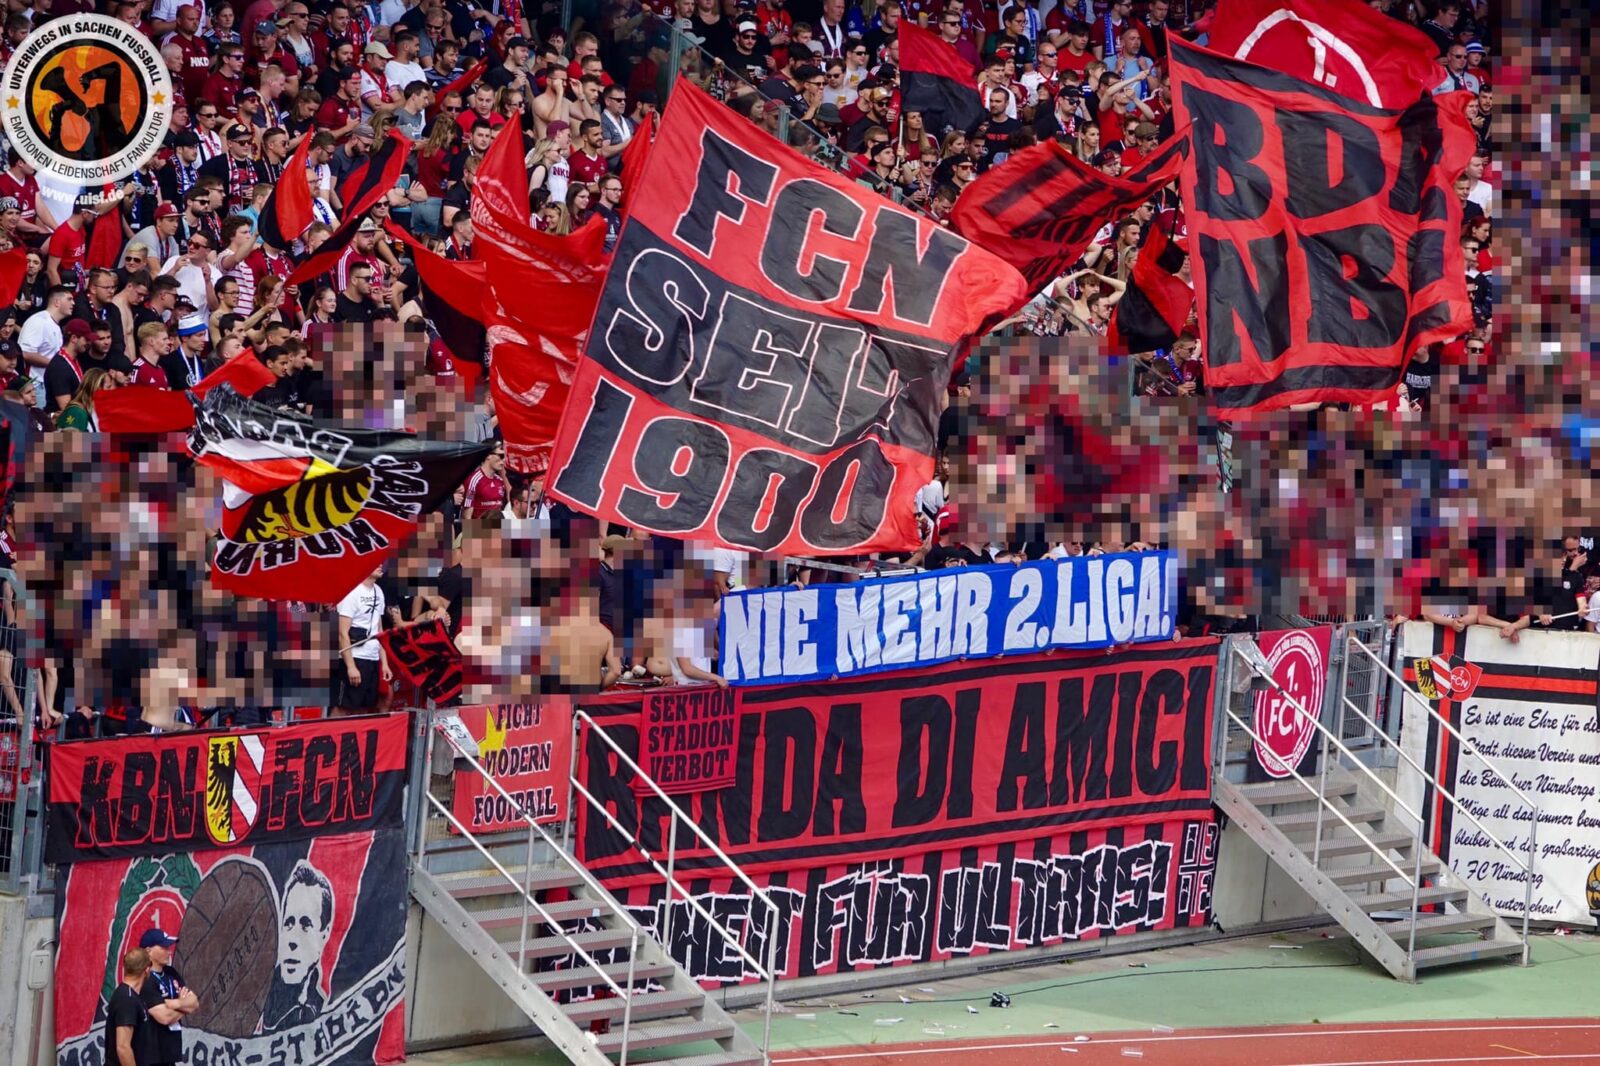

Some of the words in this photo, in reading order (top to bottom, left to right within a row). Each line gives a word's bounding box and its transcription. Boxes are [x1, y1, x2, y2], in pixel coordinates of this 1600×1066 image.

[1307, 35, 1337, 88] 1.
[672, 126, 970, 328] FCN
[552, 374, 897, 552] 1900
[722, 588, 819, 681] NIE
[834, 571, 993, 673] MEHR
[496, 703, 543, 731] FIGHT
[650, 688, 736, 723] SEKTION
[1268, 695, 1307, 736] FCN
[1465, 704, 1482, 726] Es
[1485, 711, 1501, 726] ist
[1503, 712, 1526, 728] eine
[1528, 708, 1558, 730] Ehre
[1560, 713, 1580, 736] für
[648, 719, 735, 753] STADION
[892, 688, 981, 828] DI
[996, 665, 1213, 812] AMICI
[1501, 741, 1537, 760] diesen
[1538, 742, 1576, 764] Verein
[484, 741, 553, 778] MODERN
[649, 748, 730, 783] VERBOT
[75, 746, 200, 849] KBN
[267, 729, 379, 832] FCN
[1460, 769, 1478, 786] die
[1536, 773, 1595, 802] Nürnbergs
[472, 786, 558, 826] FOOTBALL
[1493, 804, 1511, 820] all
[1512, 805, 1533, 821] das
[1455, 828, 1492, 849] bleiben
[1467, 860, 1490, 881] FC
[1491, 861, 1544, 890] Nürnbrg
[813, 858, 931, 970] FÜR
[936, 839, 1175, 953] ULTRAS!
